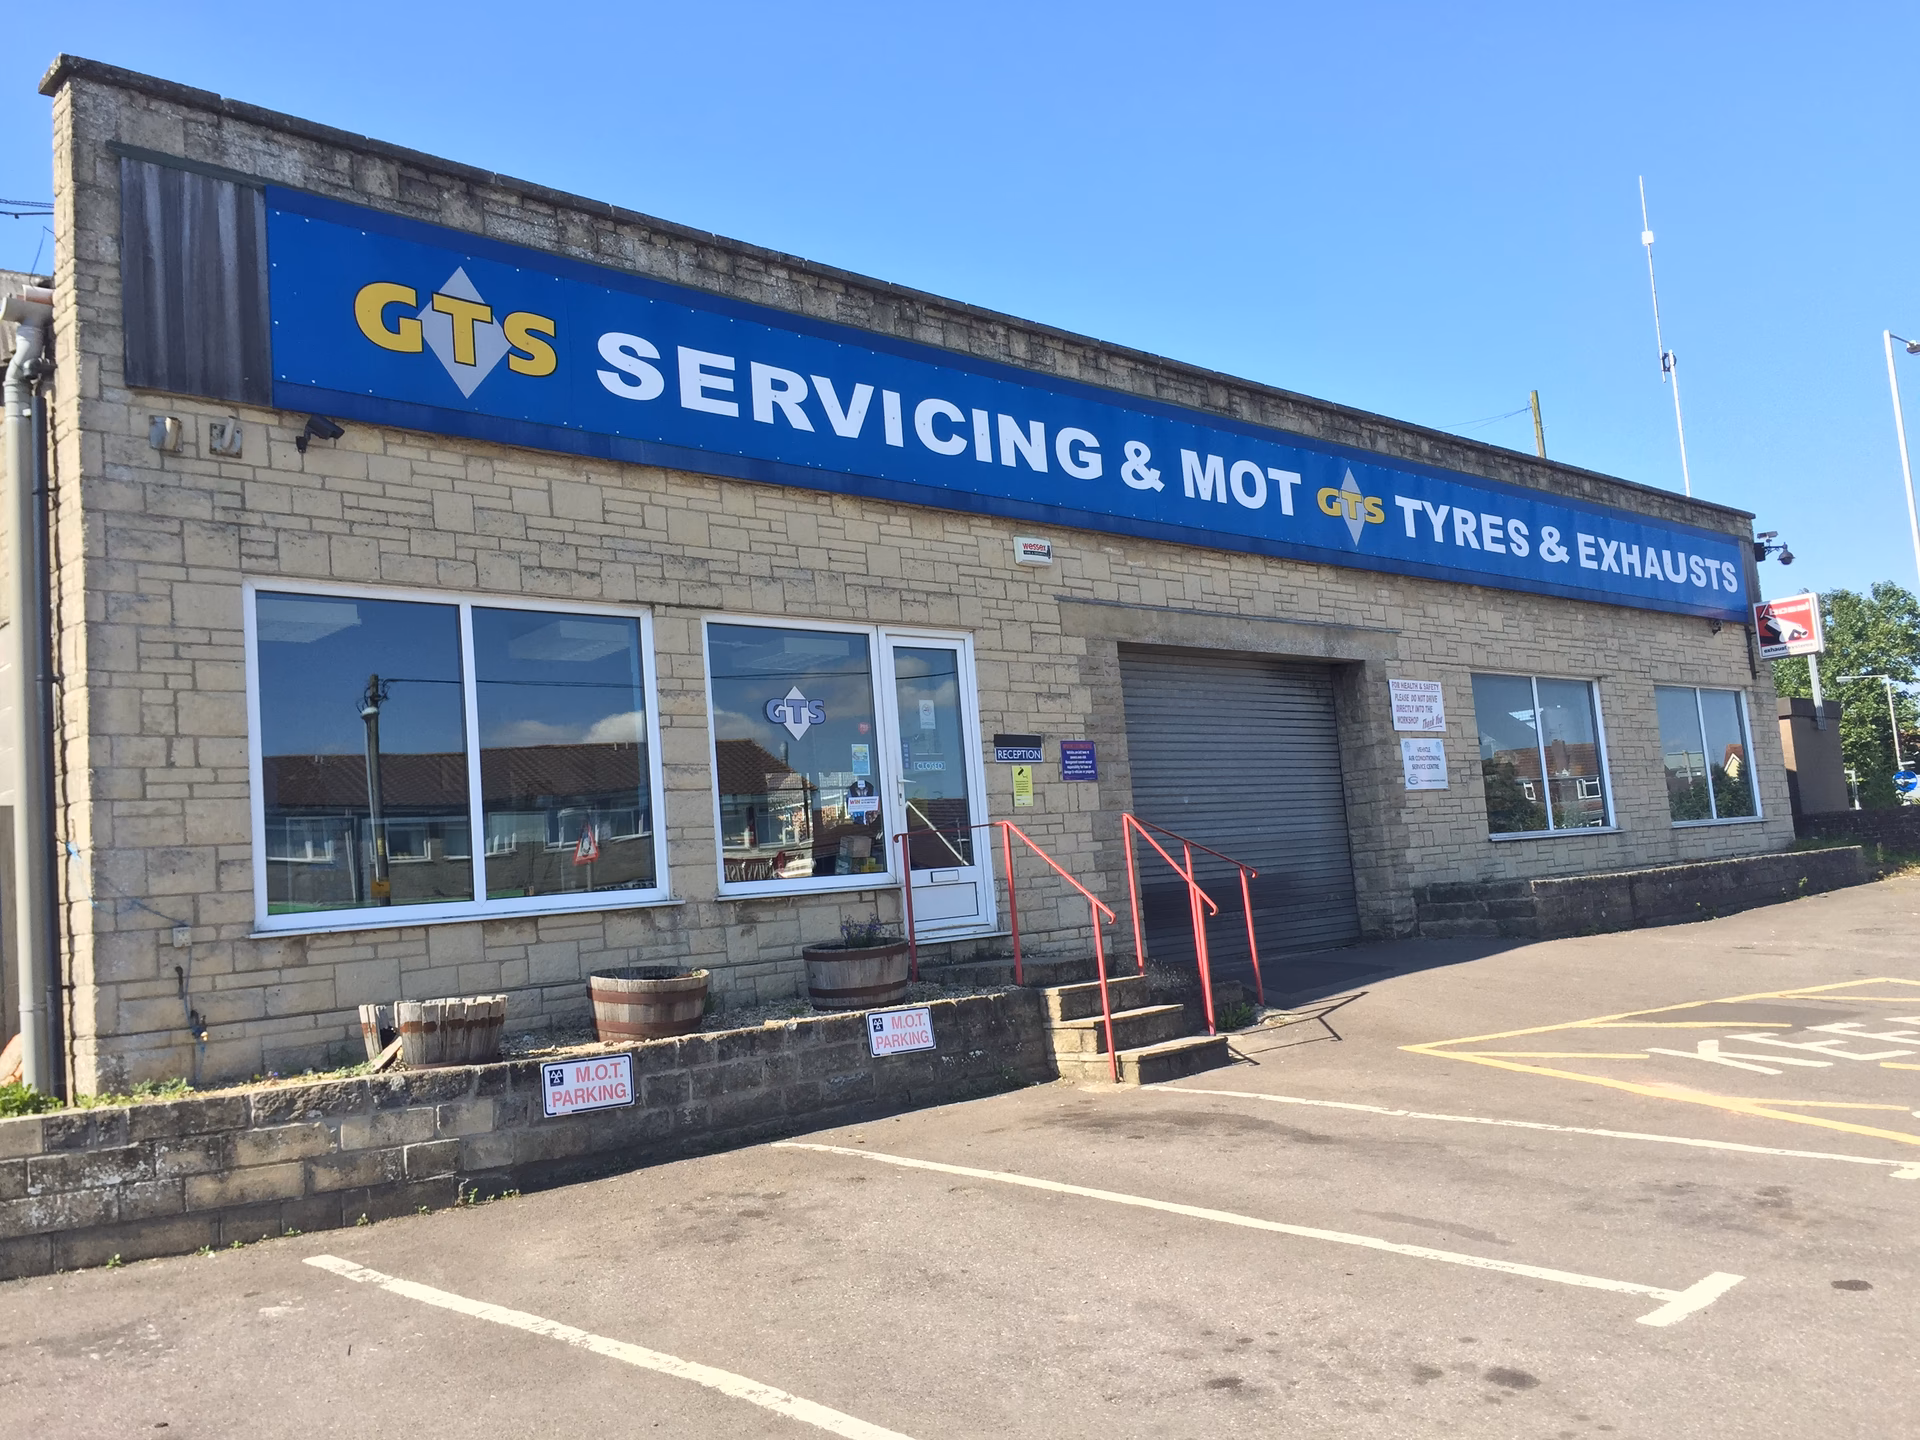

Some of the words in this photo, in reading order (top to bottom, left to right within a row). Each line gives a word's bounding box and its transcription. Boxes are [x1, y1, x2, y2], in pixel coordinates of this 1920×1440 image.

[354, 282, 558, 377] GTS
[596, 331, 1104, 480] SERVICING
[1120, 440, 1165, 493] &
[1180, 448, 1302, 517] MOT
[1316, 486, 1386, 525] GTS
[1394, 495, 1531, 558] TYRES
[1539, 525, 1570, 564] &
[1576, 532, 1738, 593] EXHAUSTS
[1764, 645, 1787, 653] exhaust
[1391, 681, 1400, 689] FOR
[1400, 682, 1418, 690] HEALTH
[1423, 683, 1439, 691] SAFETY
[1394, 693, 1410, 702] PLEASE
[1417, 694, 1426, 703] NOT
[1426, 694, 1438, 703] DRIVE
[1396, 704, 1414, 713] DIRECTLY
[765, 698, 826, 725] GTS
[997, 750, 1041, 759] RECEPTION
[917, 762, 944, 770] CLOSED
[891, 1013, 926, 1030] M.O.T.
[875, 1029, 930, 1050] PARKING
[1641, 1016, 1920, 1075] KEE
[575, 1062, 624, 1083] M.O.T.
[551, 1082, 627, 1108] PARKING
